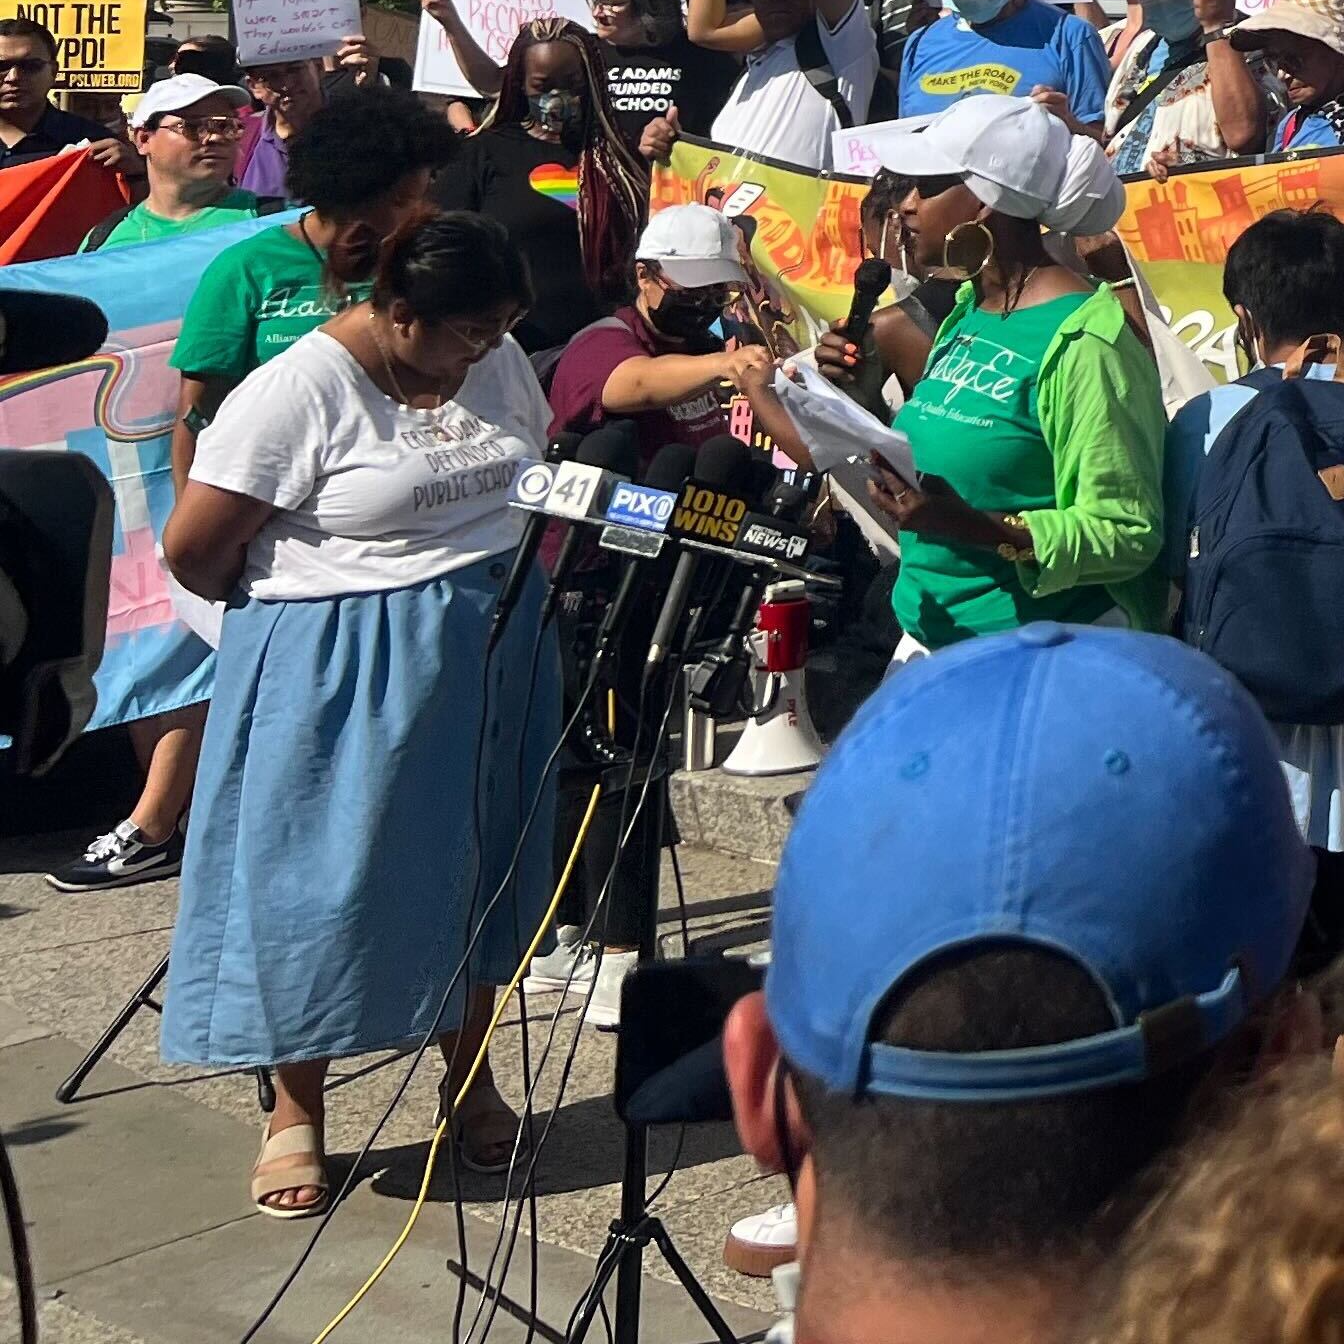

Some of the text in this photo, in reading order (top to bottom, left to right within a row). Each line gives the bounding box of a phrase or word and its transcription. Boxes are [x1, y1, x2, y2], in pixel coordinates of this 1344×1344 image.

[73, 4, 121, 35] THE
[69, 73, 139, 89] PSLWEB.ORG
[622, 67, 682, 81] ADAMS
[927, 69, 1015, 86] MAKE THE ROAD
[969, 78, 1009, 92] NEW YORK
[424, 440, 505, 473] DEFUNDED
[413, 474, 471, 512] PUBLIC
[554, 474, 589, 505] 41
[684, 484, 748, 523] 1010
[673, 508, 738, 543] WINS
[743, 528, 788, 552] NEWS
